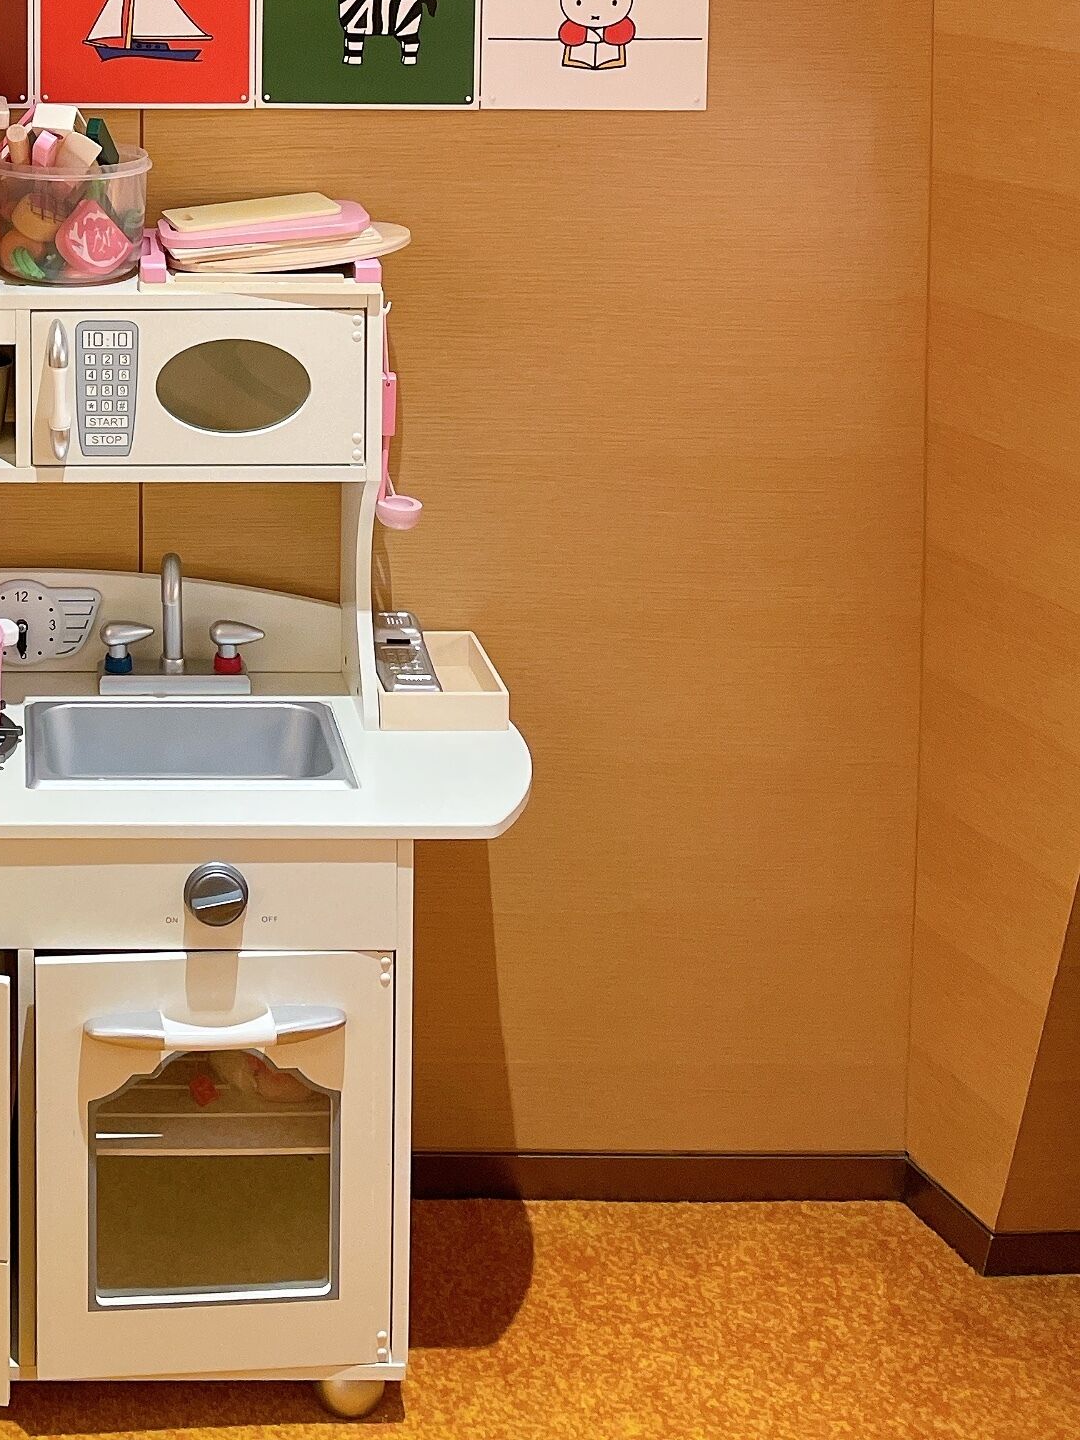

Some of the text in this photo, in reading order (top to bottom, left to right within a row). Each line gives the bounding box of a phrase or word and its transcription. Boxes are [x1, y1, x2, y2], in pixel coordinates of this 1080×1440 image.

[87, 332, 128, 347] 10:10
[87, 355, 128, 364] 1 2 3
[88, 370, 127, 380] 4 5 6
[89, 386, 126, 395] 7 8 9
[103, 401, 110, 410] 0
[89, 417, 125, 427] START
[91, 435, 122, 444] STOP
[14, 591, 29, 602] 12
[48, 619, 56, 631] 3
[165, 916, 179, 924] ON
[261, 915, 278, 923] OFF
